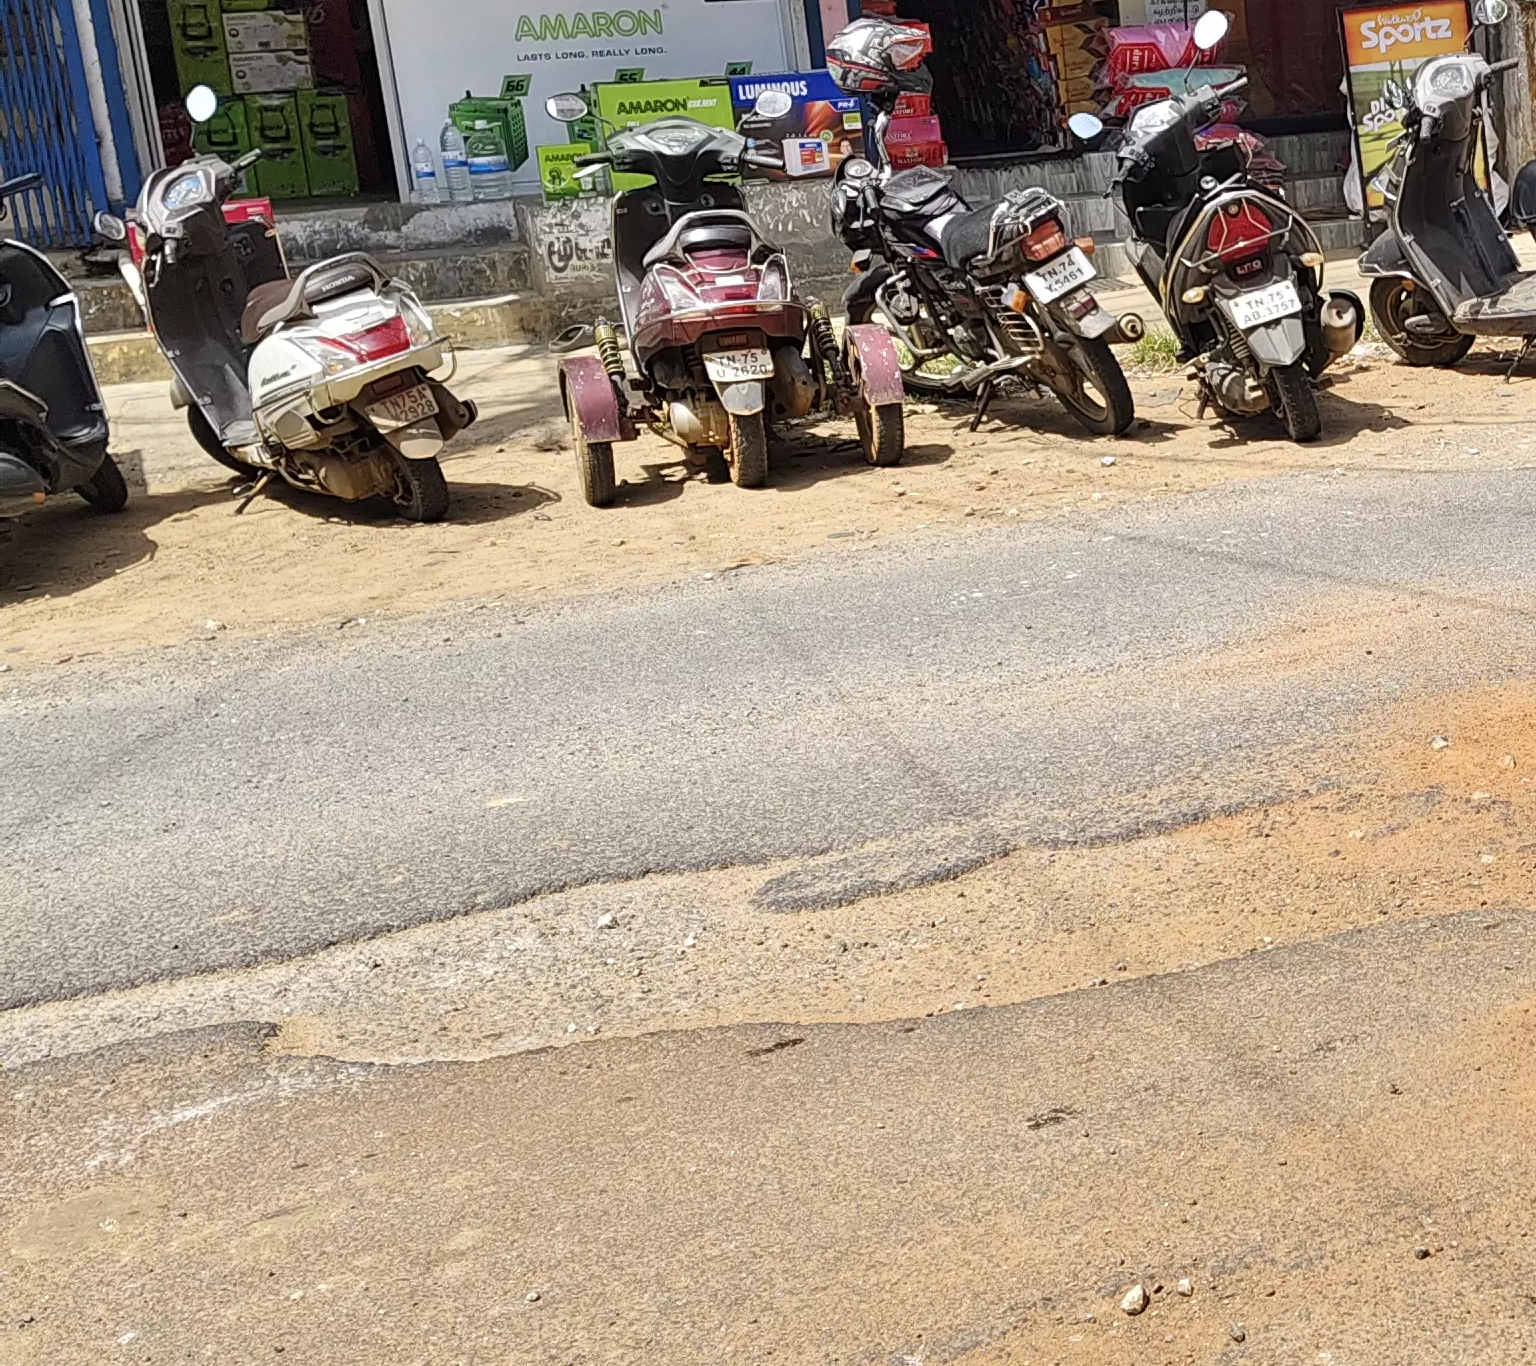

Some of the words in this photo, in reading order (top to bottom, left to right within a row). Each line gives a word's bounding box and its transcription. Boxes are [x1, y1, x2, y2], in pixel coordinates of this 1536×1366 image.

[515, 8, 664, 42] AMARON
[1360, 16, 1452, 54] Sportz
[516, 53, 552, 62] LASTS
[591, 48, 631, 58] REALLY
[505, 79, 526, 92] 66
[737, 80, 808, 101] LUMINOUS
[617, 98, 688, 115] AMARON
[321, 275, 356, 293] HONDA
